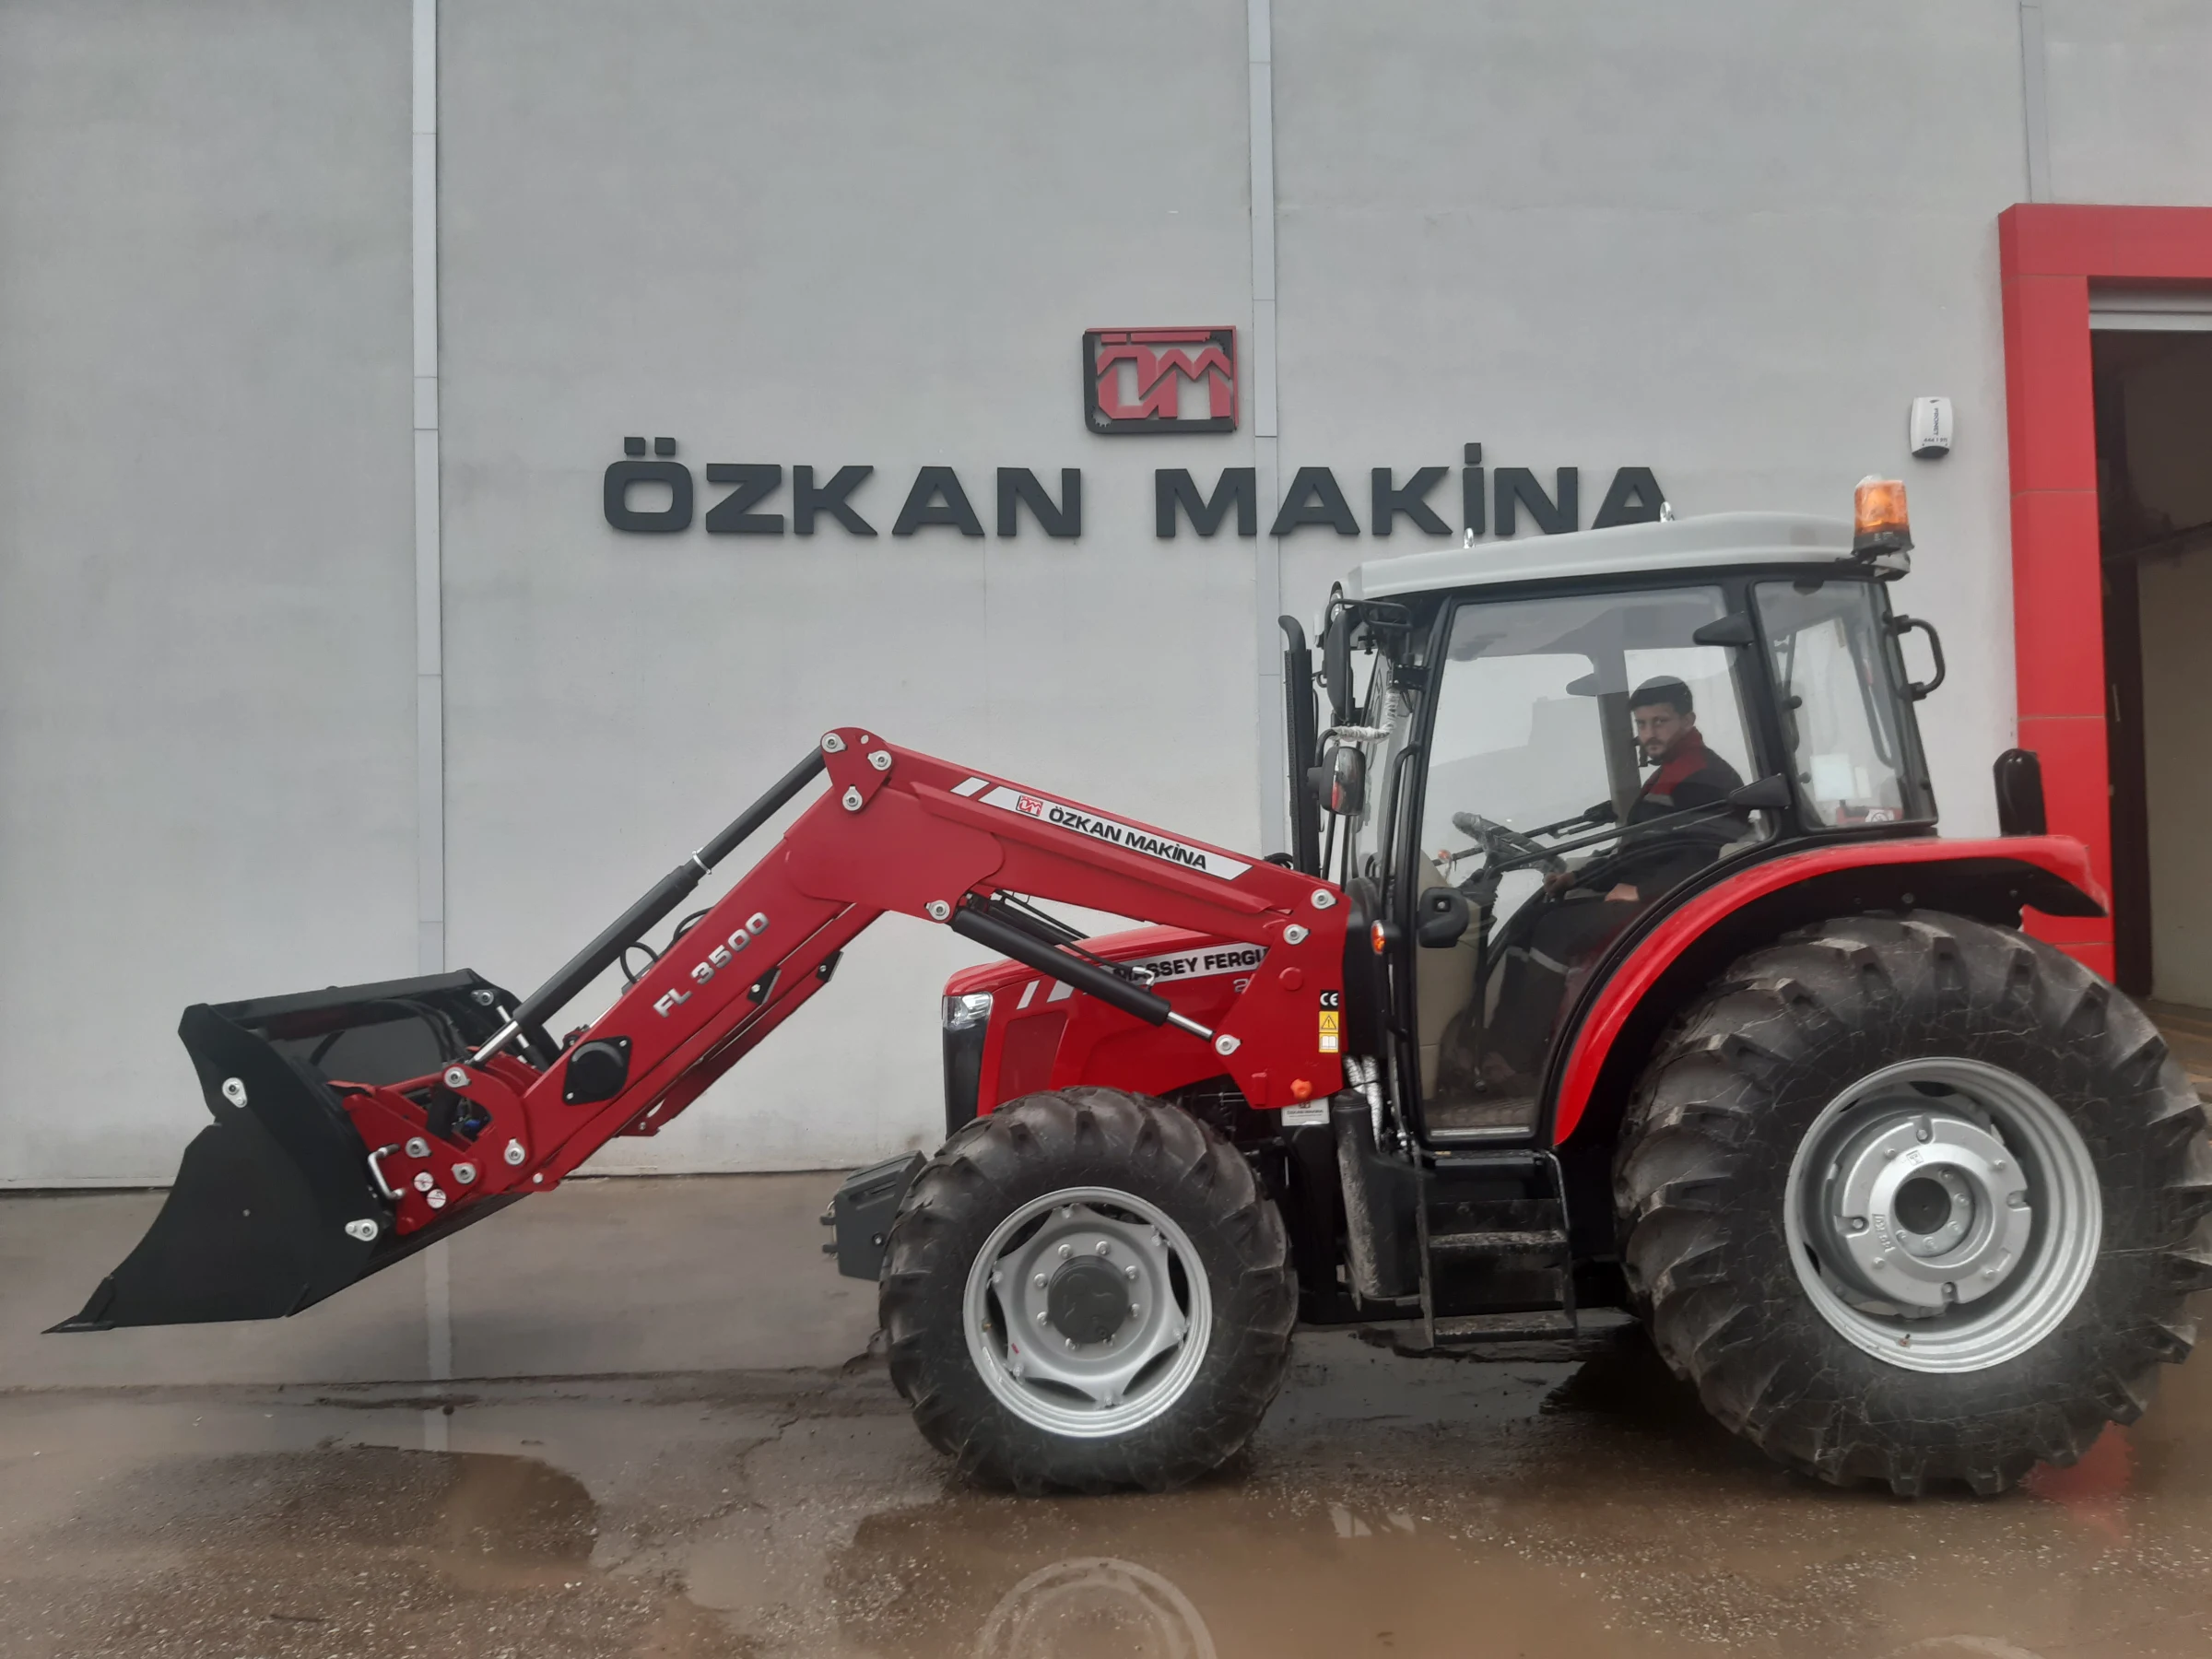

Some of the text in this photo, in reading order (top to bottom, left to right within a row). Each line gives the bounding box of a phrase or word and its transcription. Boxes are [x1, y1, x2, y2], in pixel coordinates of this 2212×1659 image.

[604, 437, 1665, 537] ÖZKAN MAKİNA
[1049, 806, 1206, 870] ÖZKAN MAKİNA
[653, 912, 770, 1018] FL 3500
[1320, 993, 1338, 1006] CE
